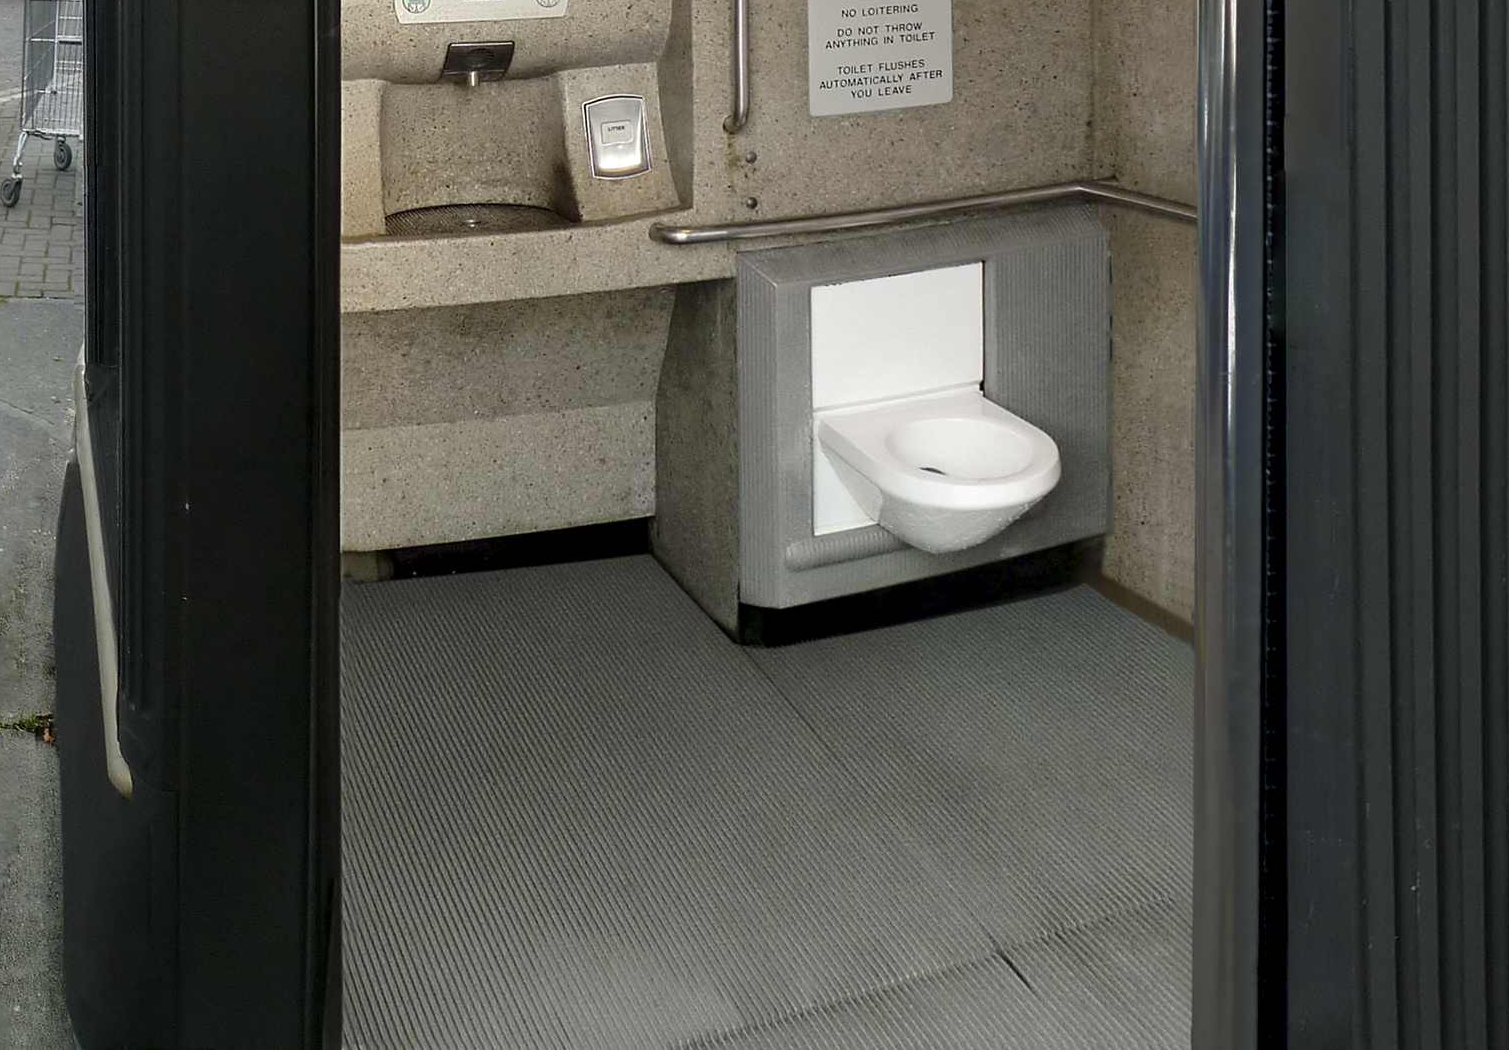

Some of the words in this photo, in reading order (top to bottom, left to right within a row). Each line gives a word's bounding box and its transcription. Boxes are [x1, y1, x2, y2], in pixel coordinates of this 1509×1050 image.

[842, 9, 856, 18] NO
[862, 4, 918, 17] LOITERING
[837, 28, 852, 37] DO
[858, 26, 879, 35] NOT
[886, 23, 922, 33] THROW
[826, 37, 878, 49] ANYTHING
[884, 36, 894, 44] IN
[900, 32, 935, 43] TOILET
[838, 64, 873, 75] TOILET
[879, 59, 925, 71] FLUSHES
[820, 74, 904, 89] AUTOMATICALLY
[910, 70, 942, 81] AFTER
[851, 89, 872, 98] YOU
[878, 85, 912, 96] LEAVE
